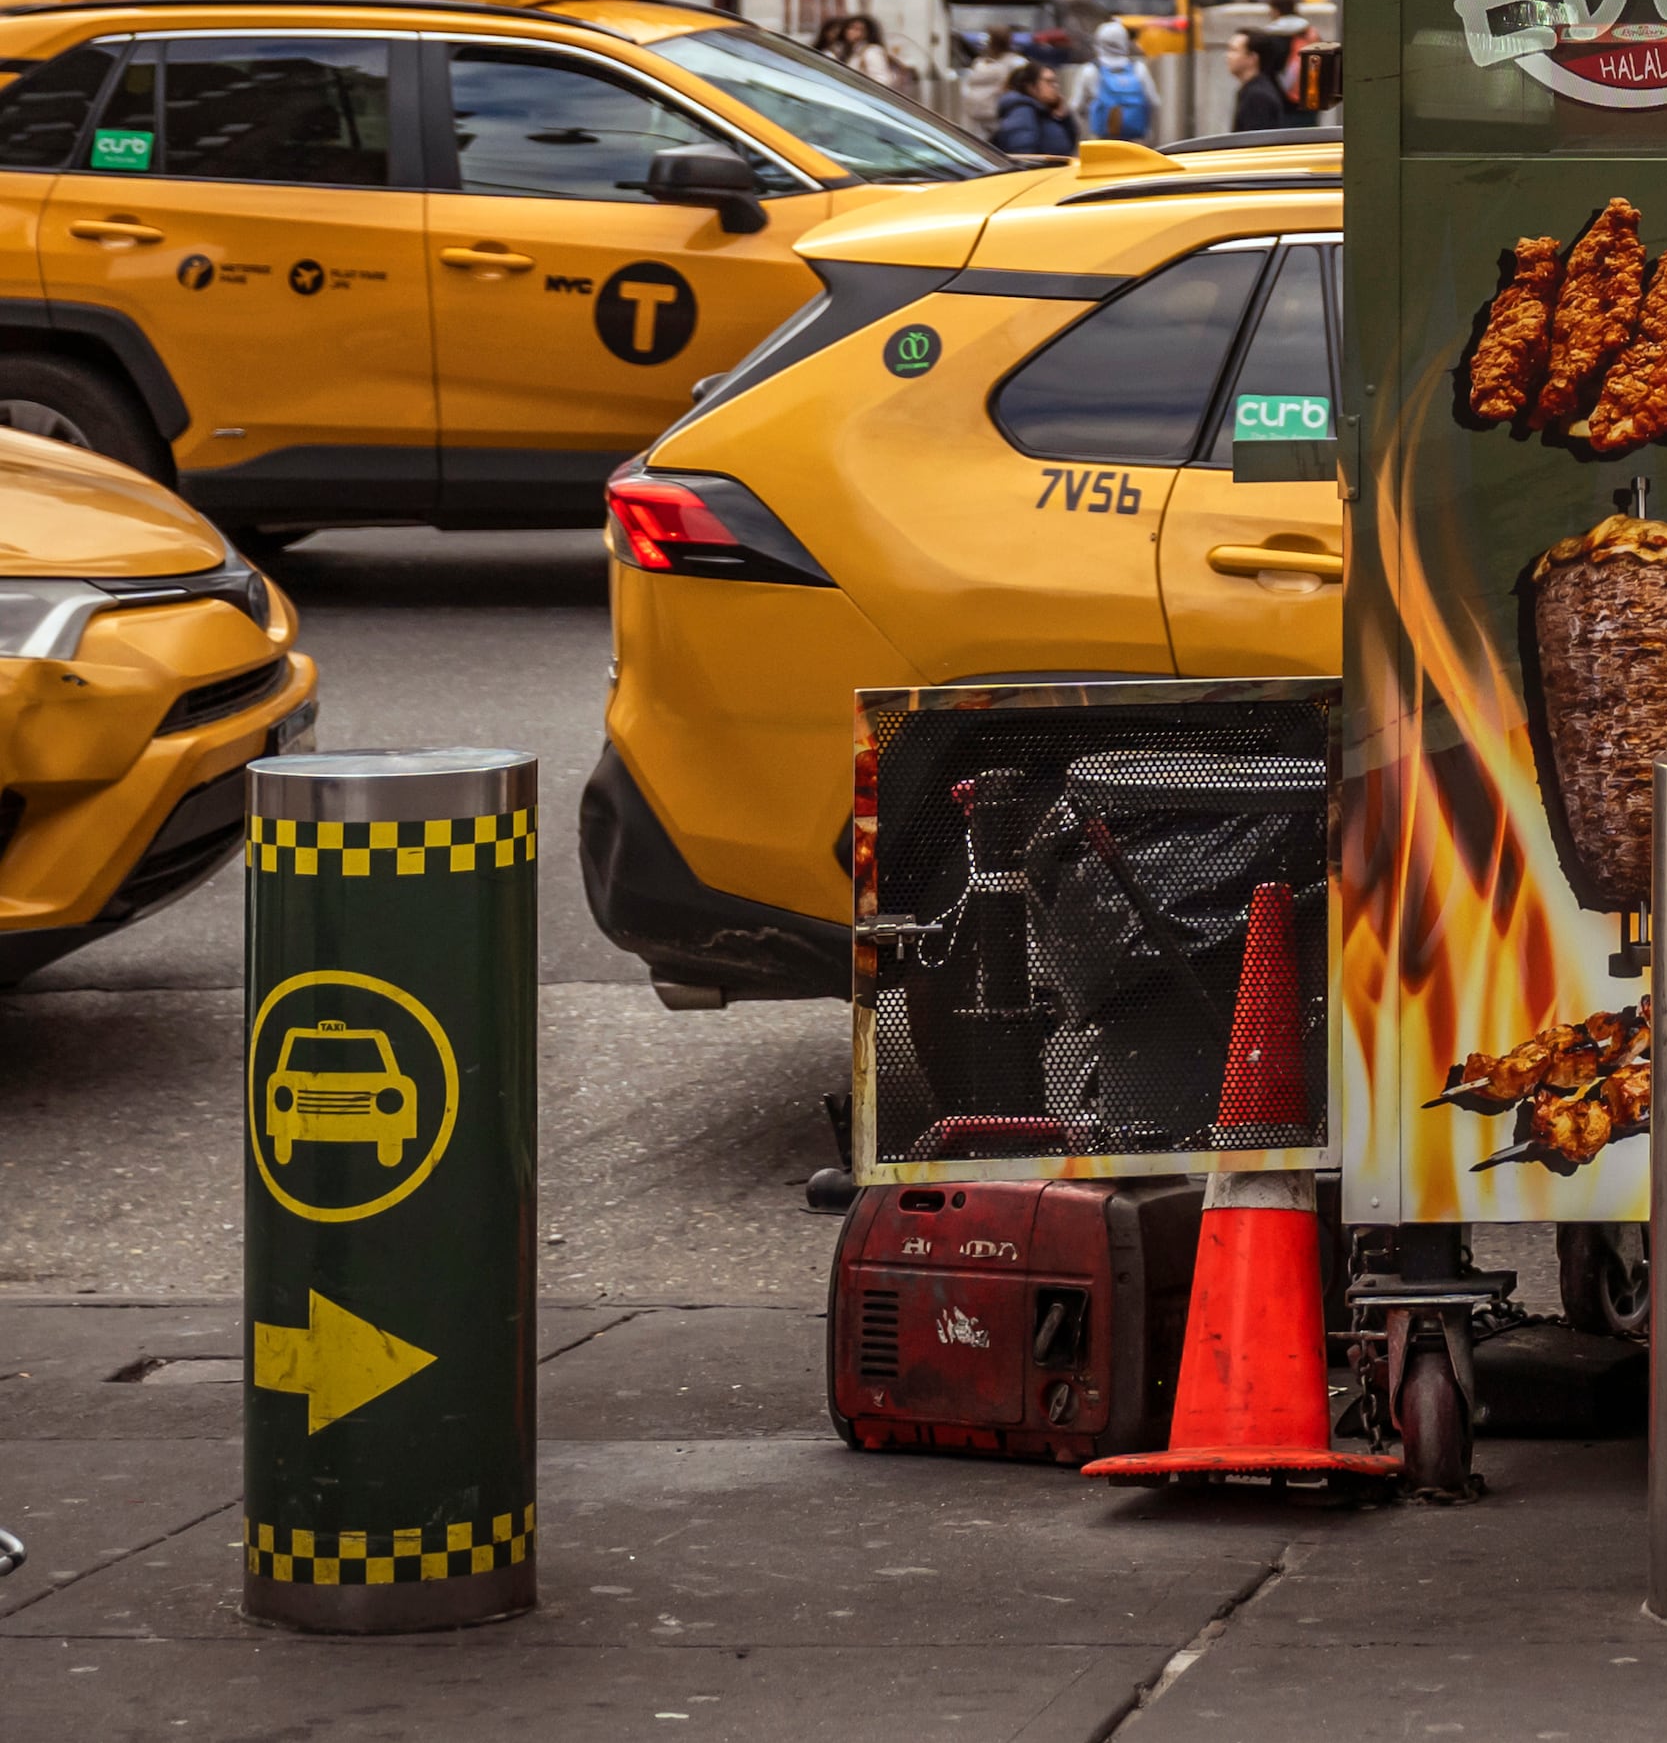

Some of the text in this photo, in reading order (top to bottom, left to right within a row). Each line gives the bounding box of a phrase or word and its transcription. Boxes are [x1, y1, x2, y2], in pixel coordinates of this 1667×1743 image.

[97, 136, 148, 155] curb
[545, 274, 594, 297] NYC
[619, 279, 678, 354] T
[1236, 398, 1328, 430] curb
[319, 1022, 345, 1032] TAXI
